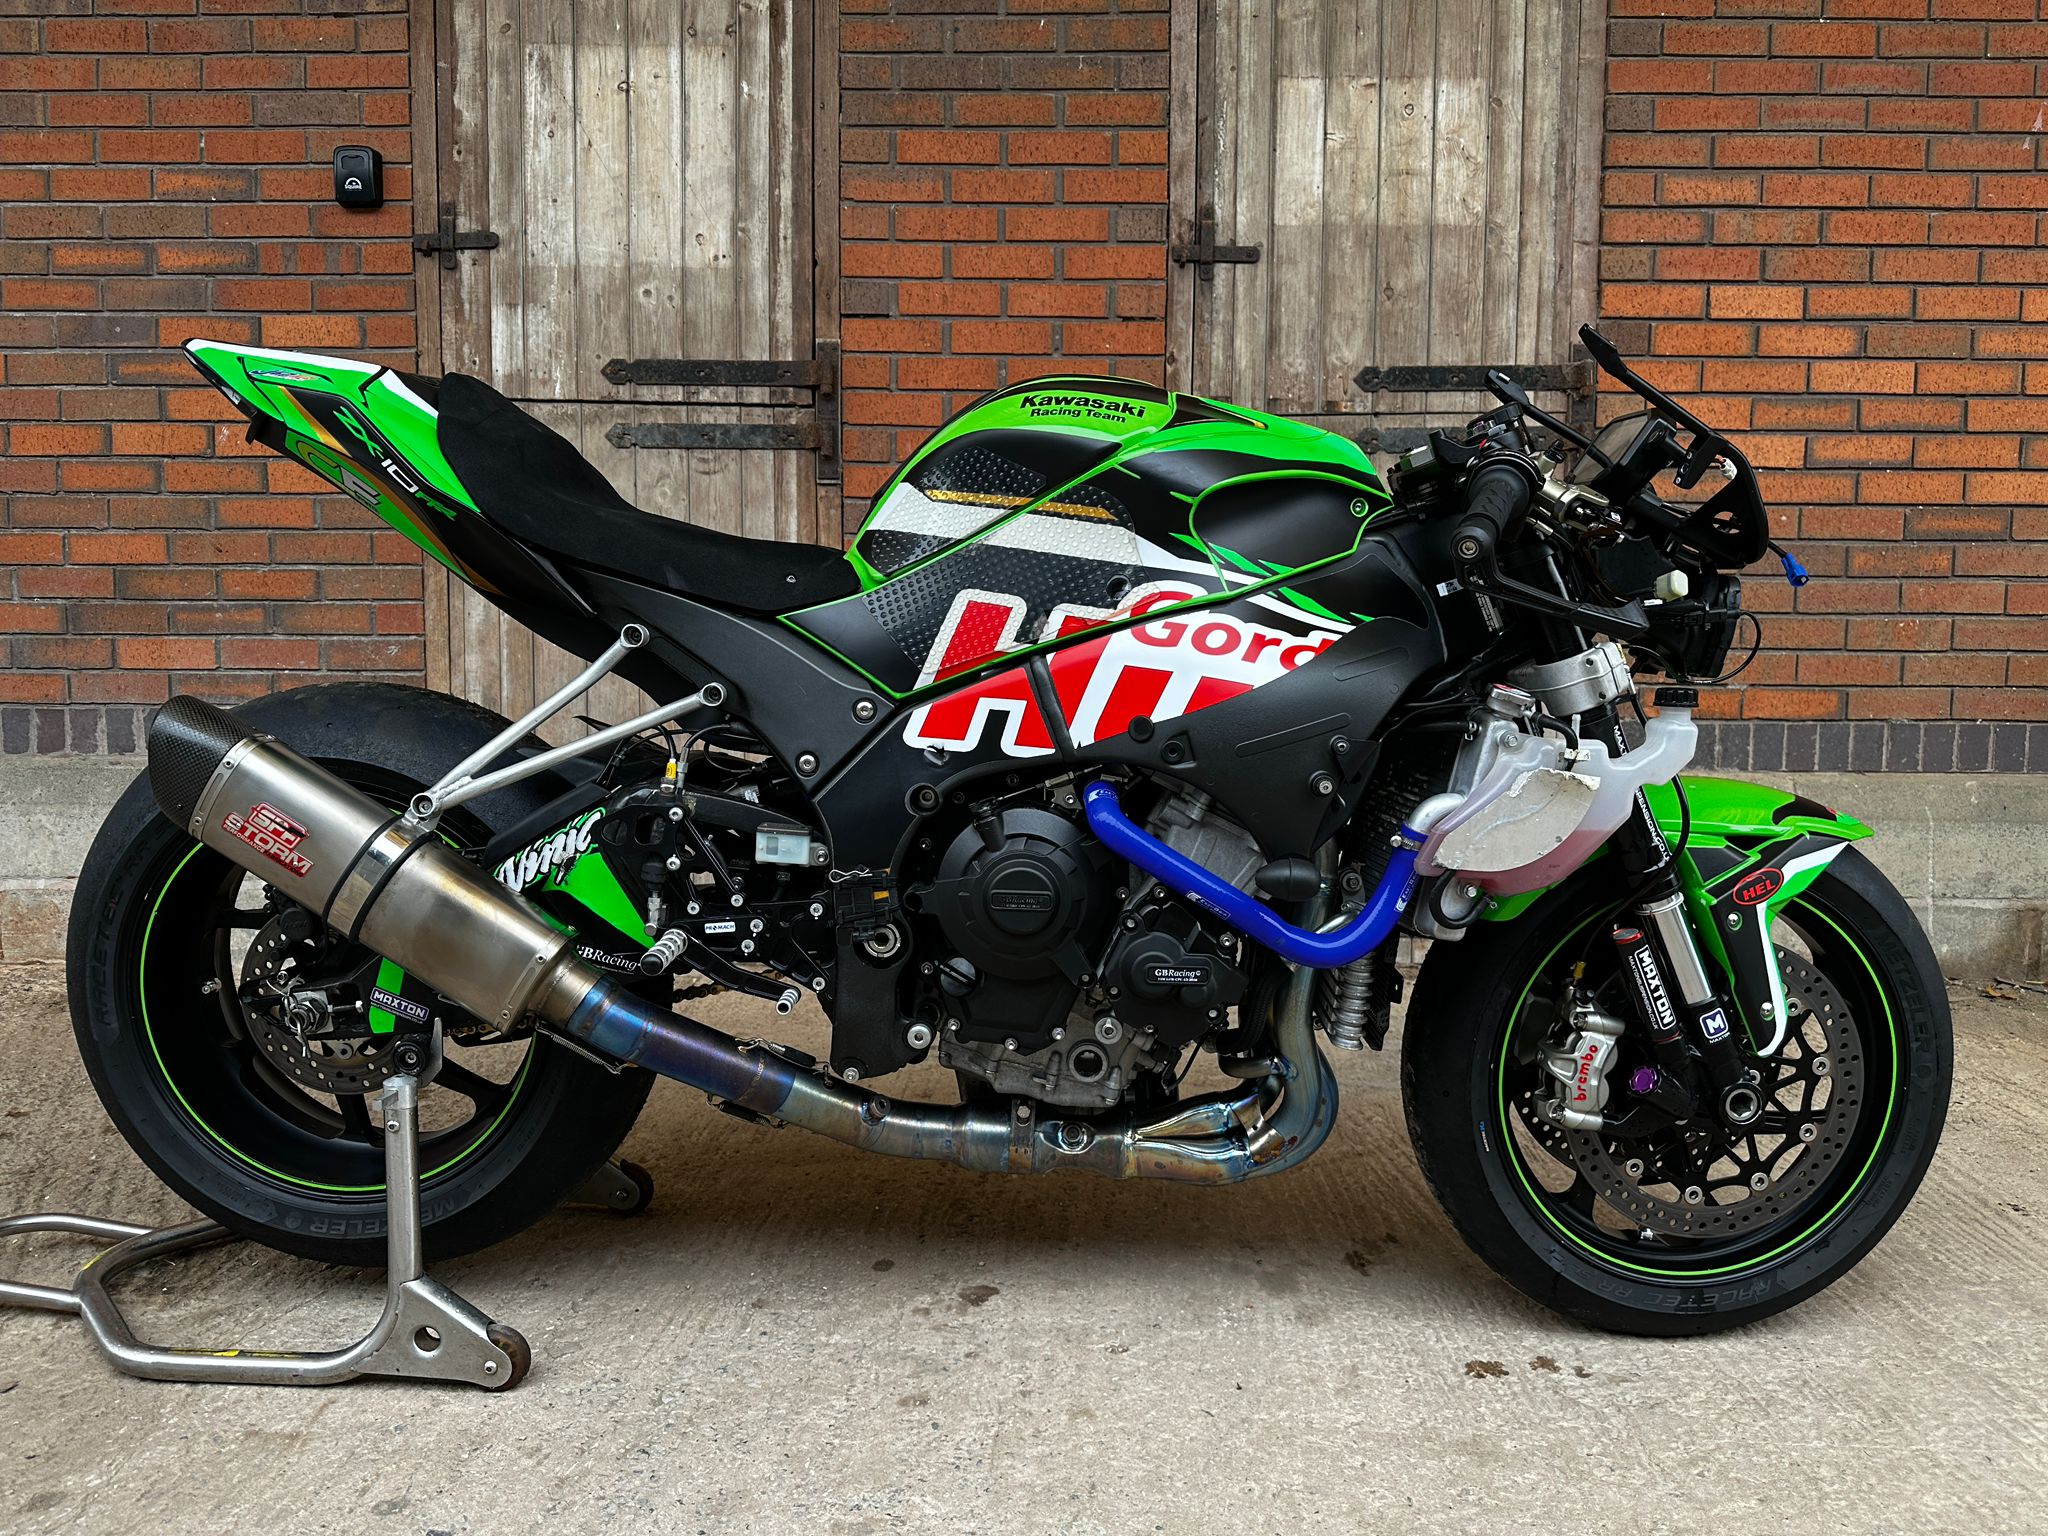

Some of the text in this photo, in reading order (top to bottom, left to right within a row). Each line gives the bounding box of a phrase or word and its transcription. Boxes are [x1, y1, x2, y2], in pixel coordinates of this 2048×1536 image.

[1020, 394, 1146, 418] Kawasaki
[1030, 407, 1126, 423] Racing Team
[224, 813, 314, 874] STORM
[1742, 879, 1776, 901] HEL
[1638, 948, 1674, 1025] MAXTON
[373, 990, 426, 1018] MAXTON
[1705, 1013, 1725, 1034] M
[1573, 1044, 1599, 1102] brembo
